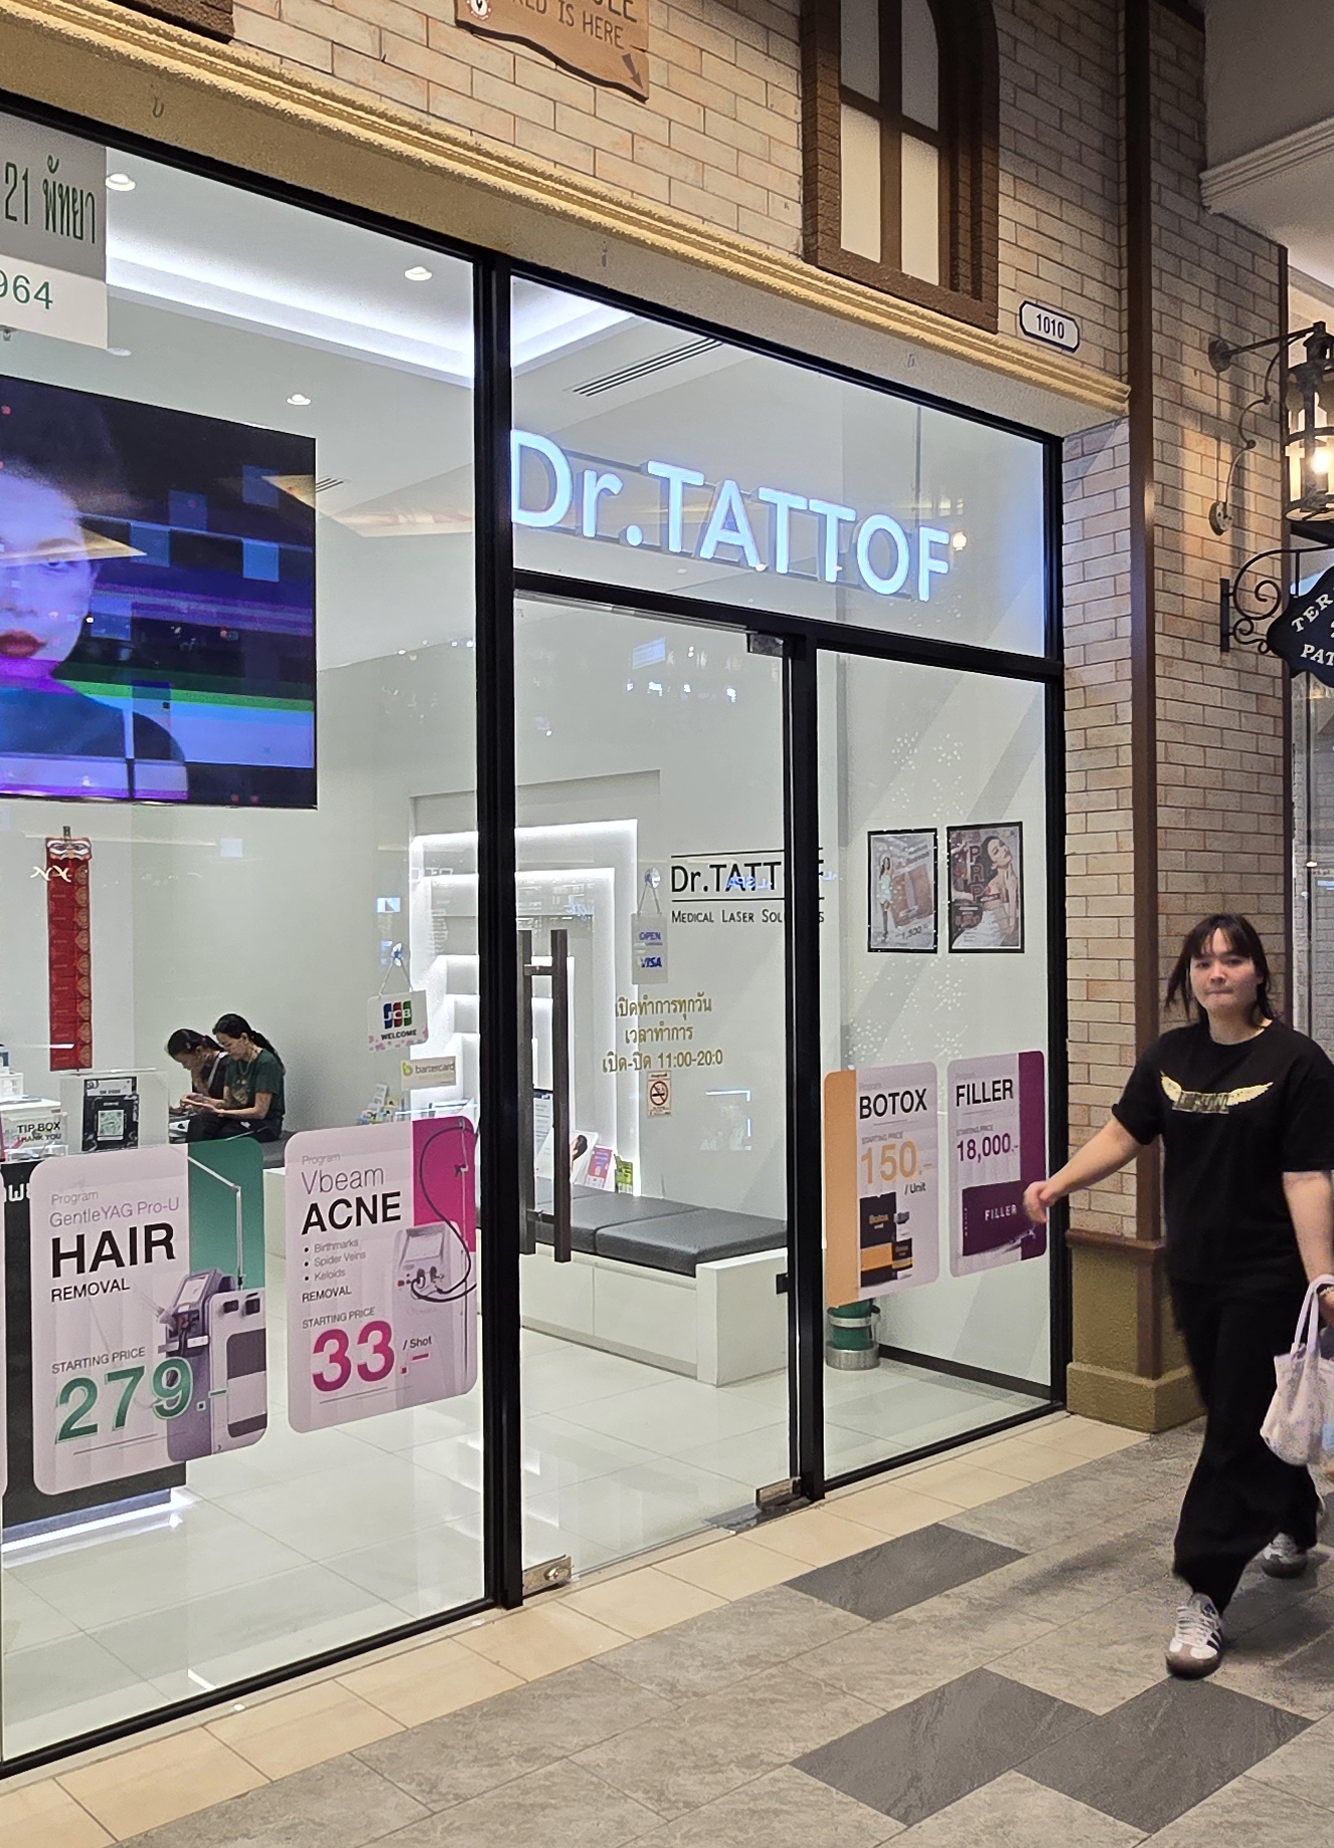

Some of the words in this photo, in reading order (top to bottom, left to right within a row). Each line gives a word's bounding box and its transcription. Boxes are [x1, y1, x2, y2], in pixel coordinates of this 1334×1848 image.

[558, 2, 575, 28] IS
[582, 10, 625, 50] HERE
[4, 162, 30, 225] 21
[43, 154, 97, 245] พัทยา
[1036, 313, 1065, 339] 1010
[512, 428, 950, 602] Dr.TATTOF
[671, 861, 824, 893] Dr.TATT
[671, 910, 714, 923] MEDICAL
[721, 909, 755, 923] LASER
[639, 932, 661, 941] OPEN
[640, 957, 663, 968] VISA
[616, 992, 712, 1020] เปิดทำการทุกวัน
[380, 1029, 417, 1041] WELCOME
[625, 1021, 694, 1044] เวลาทำการ
[415, 1061, 455, 1074] bartercard
[657, 1048, 724, 1069] 11:00-20:0
[859, 1087, 927, 1120] BOTOX
[955, 1078, 1014, 1107] FILLER
[17, 1124, 35, 1134] TIP
[37, 1121, 61, 1132] BOX
[956, 1132, 1019, 1163] 18,000.-
[861, 1138, 934, 1185] 150.-
[301, 1167, 384, 1195] Vbeam
[51, 1189, 99, 1206] Program
[49, 1202, 134, 1228] GentleYAG
[137, 1196, 180, 1217] Pro-U
[301, 1190, 402, 1236] ACNE
[984, 1204, 1017, 1222] FILLER
[51, 1220, 176, 1279] HAIR
[50, 1278, 131, 1303] REMOVAL
[301, 1284, 352, 1303] REMOVAL
[302, 1312, 347, 1329] STARTING
[348, 1307, 376, 1322] PRICE
[409, 1335, 433, 1349] Shot
[51, 1353, 110, 1375] STARTING
[111, 1347, 146, 1364] PRICE
